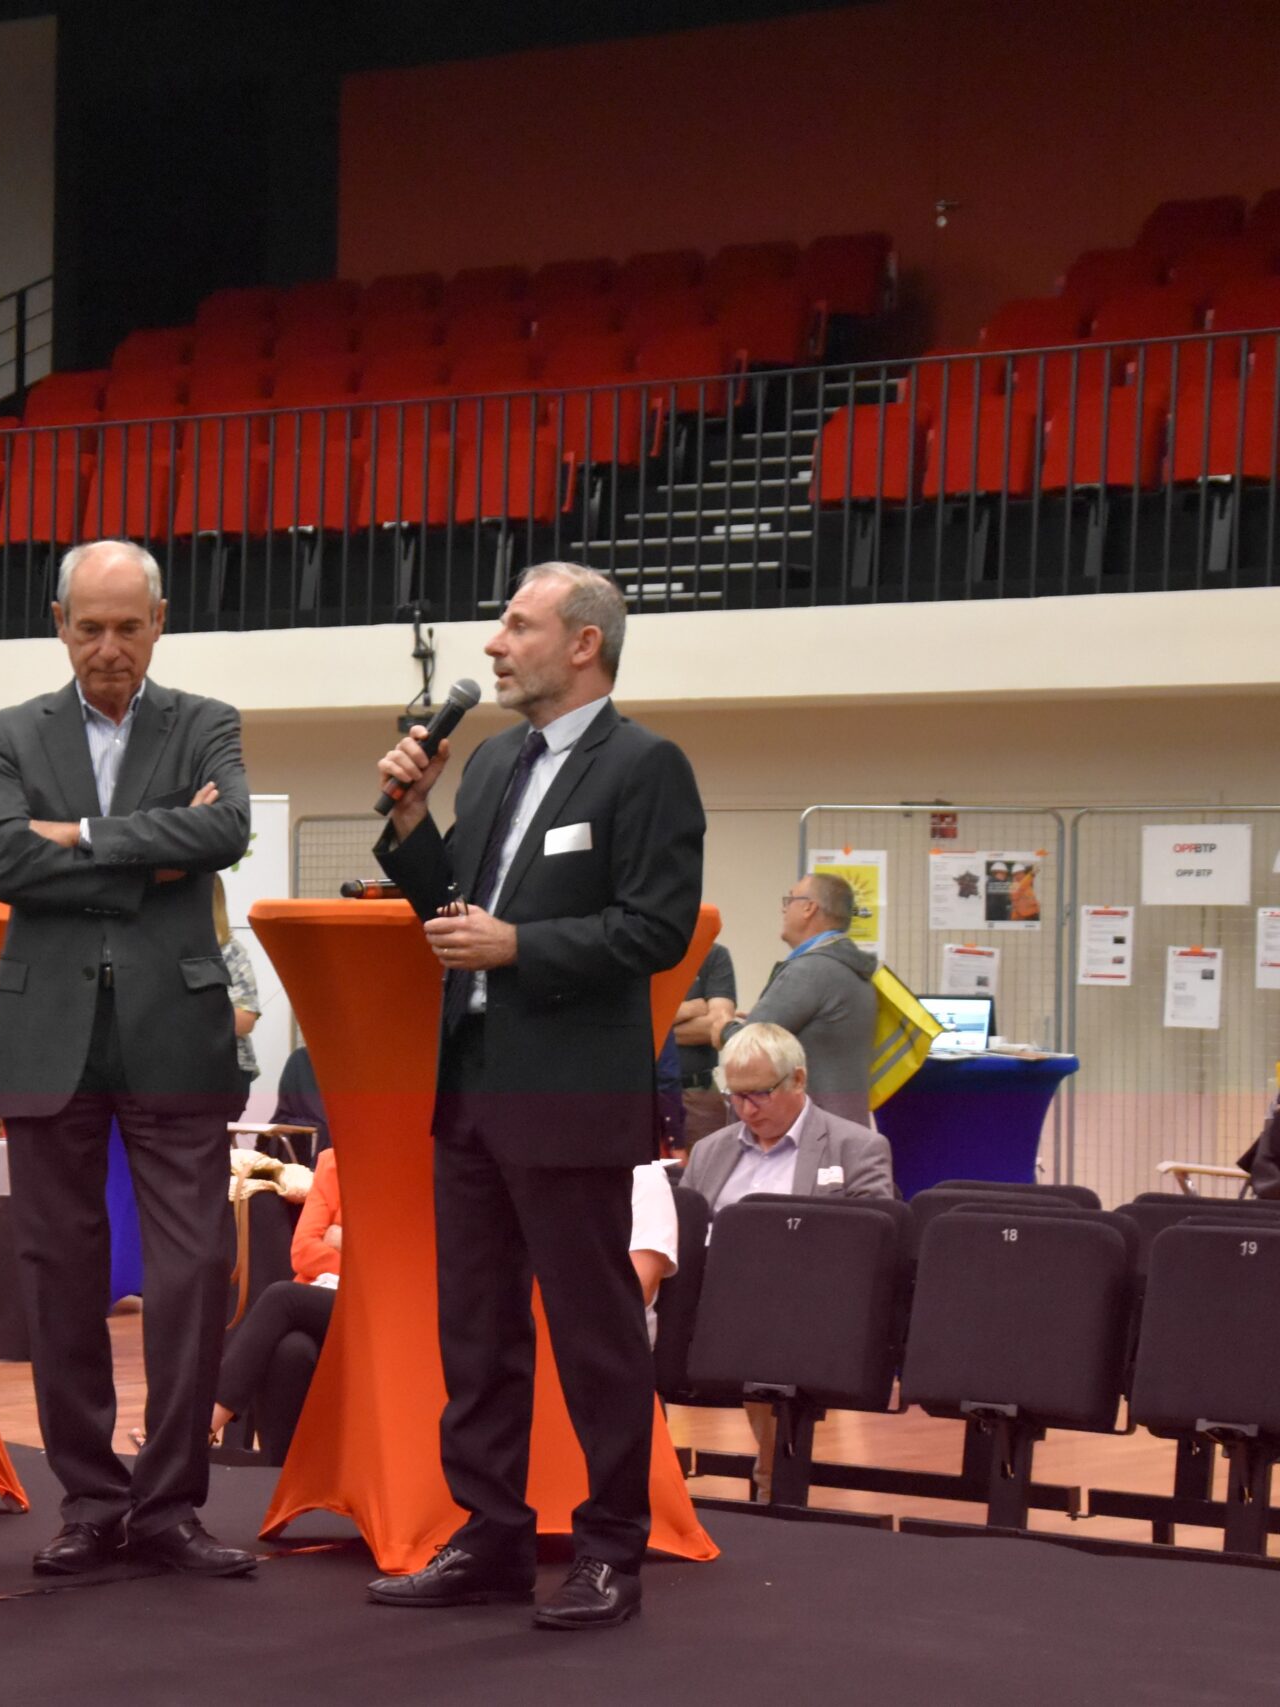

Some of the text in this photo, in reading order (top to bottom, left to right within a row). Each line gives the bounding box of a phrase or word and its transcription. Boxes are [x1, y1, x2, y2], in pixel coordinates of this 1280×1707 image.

[1173, 843, 1217, 853] OPPBTP
[786, 1217, 802, 1230] 17
[1001, 1229, 1018, 1241] 18
[1240, 1241, 1257, 1256] 19
